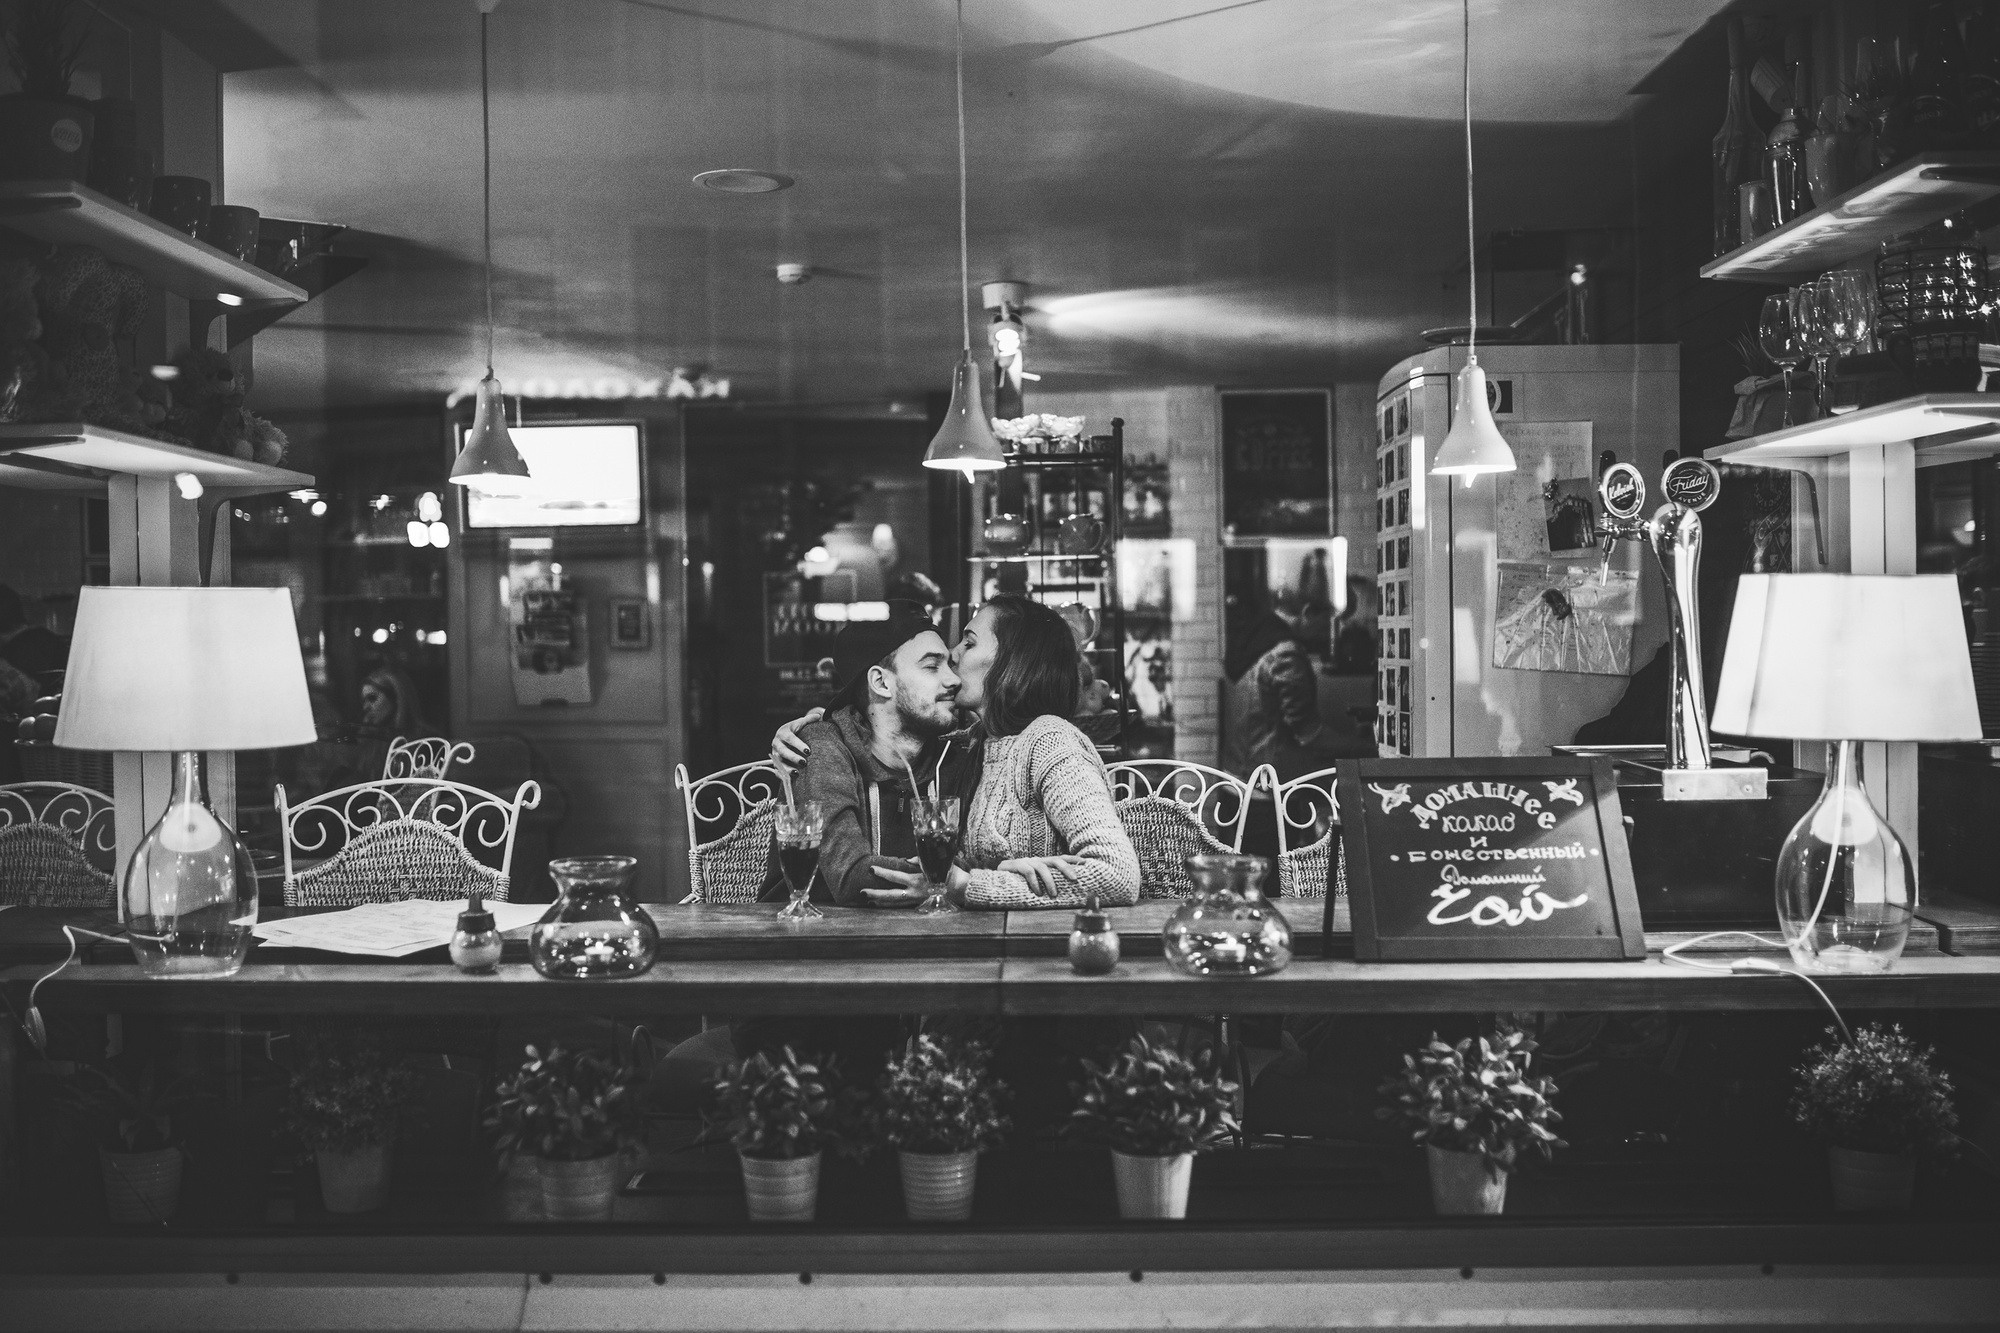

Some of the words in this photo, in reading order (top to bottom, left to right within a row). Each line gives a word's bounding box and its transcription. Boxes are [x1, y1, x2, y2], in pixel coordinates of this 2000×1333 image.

[1669, 473, 1710, 497] Friday
[1442, 812, 1516, 833] какао
[1427, 884, 1589, 926] Чай
